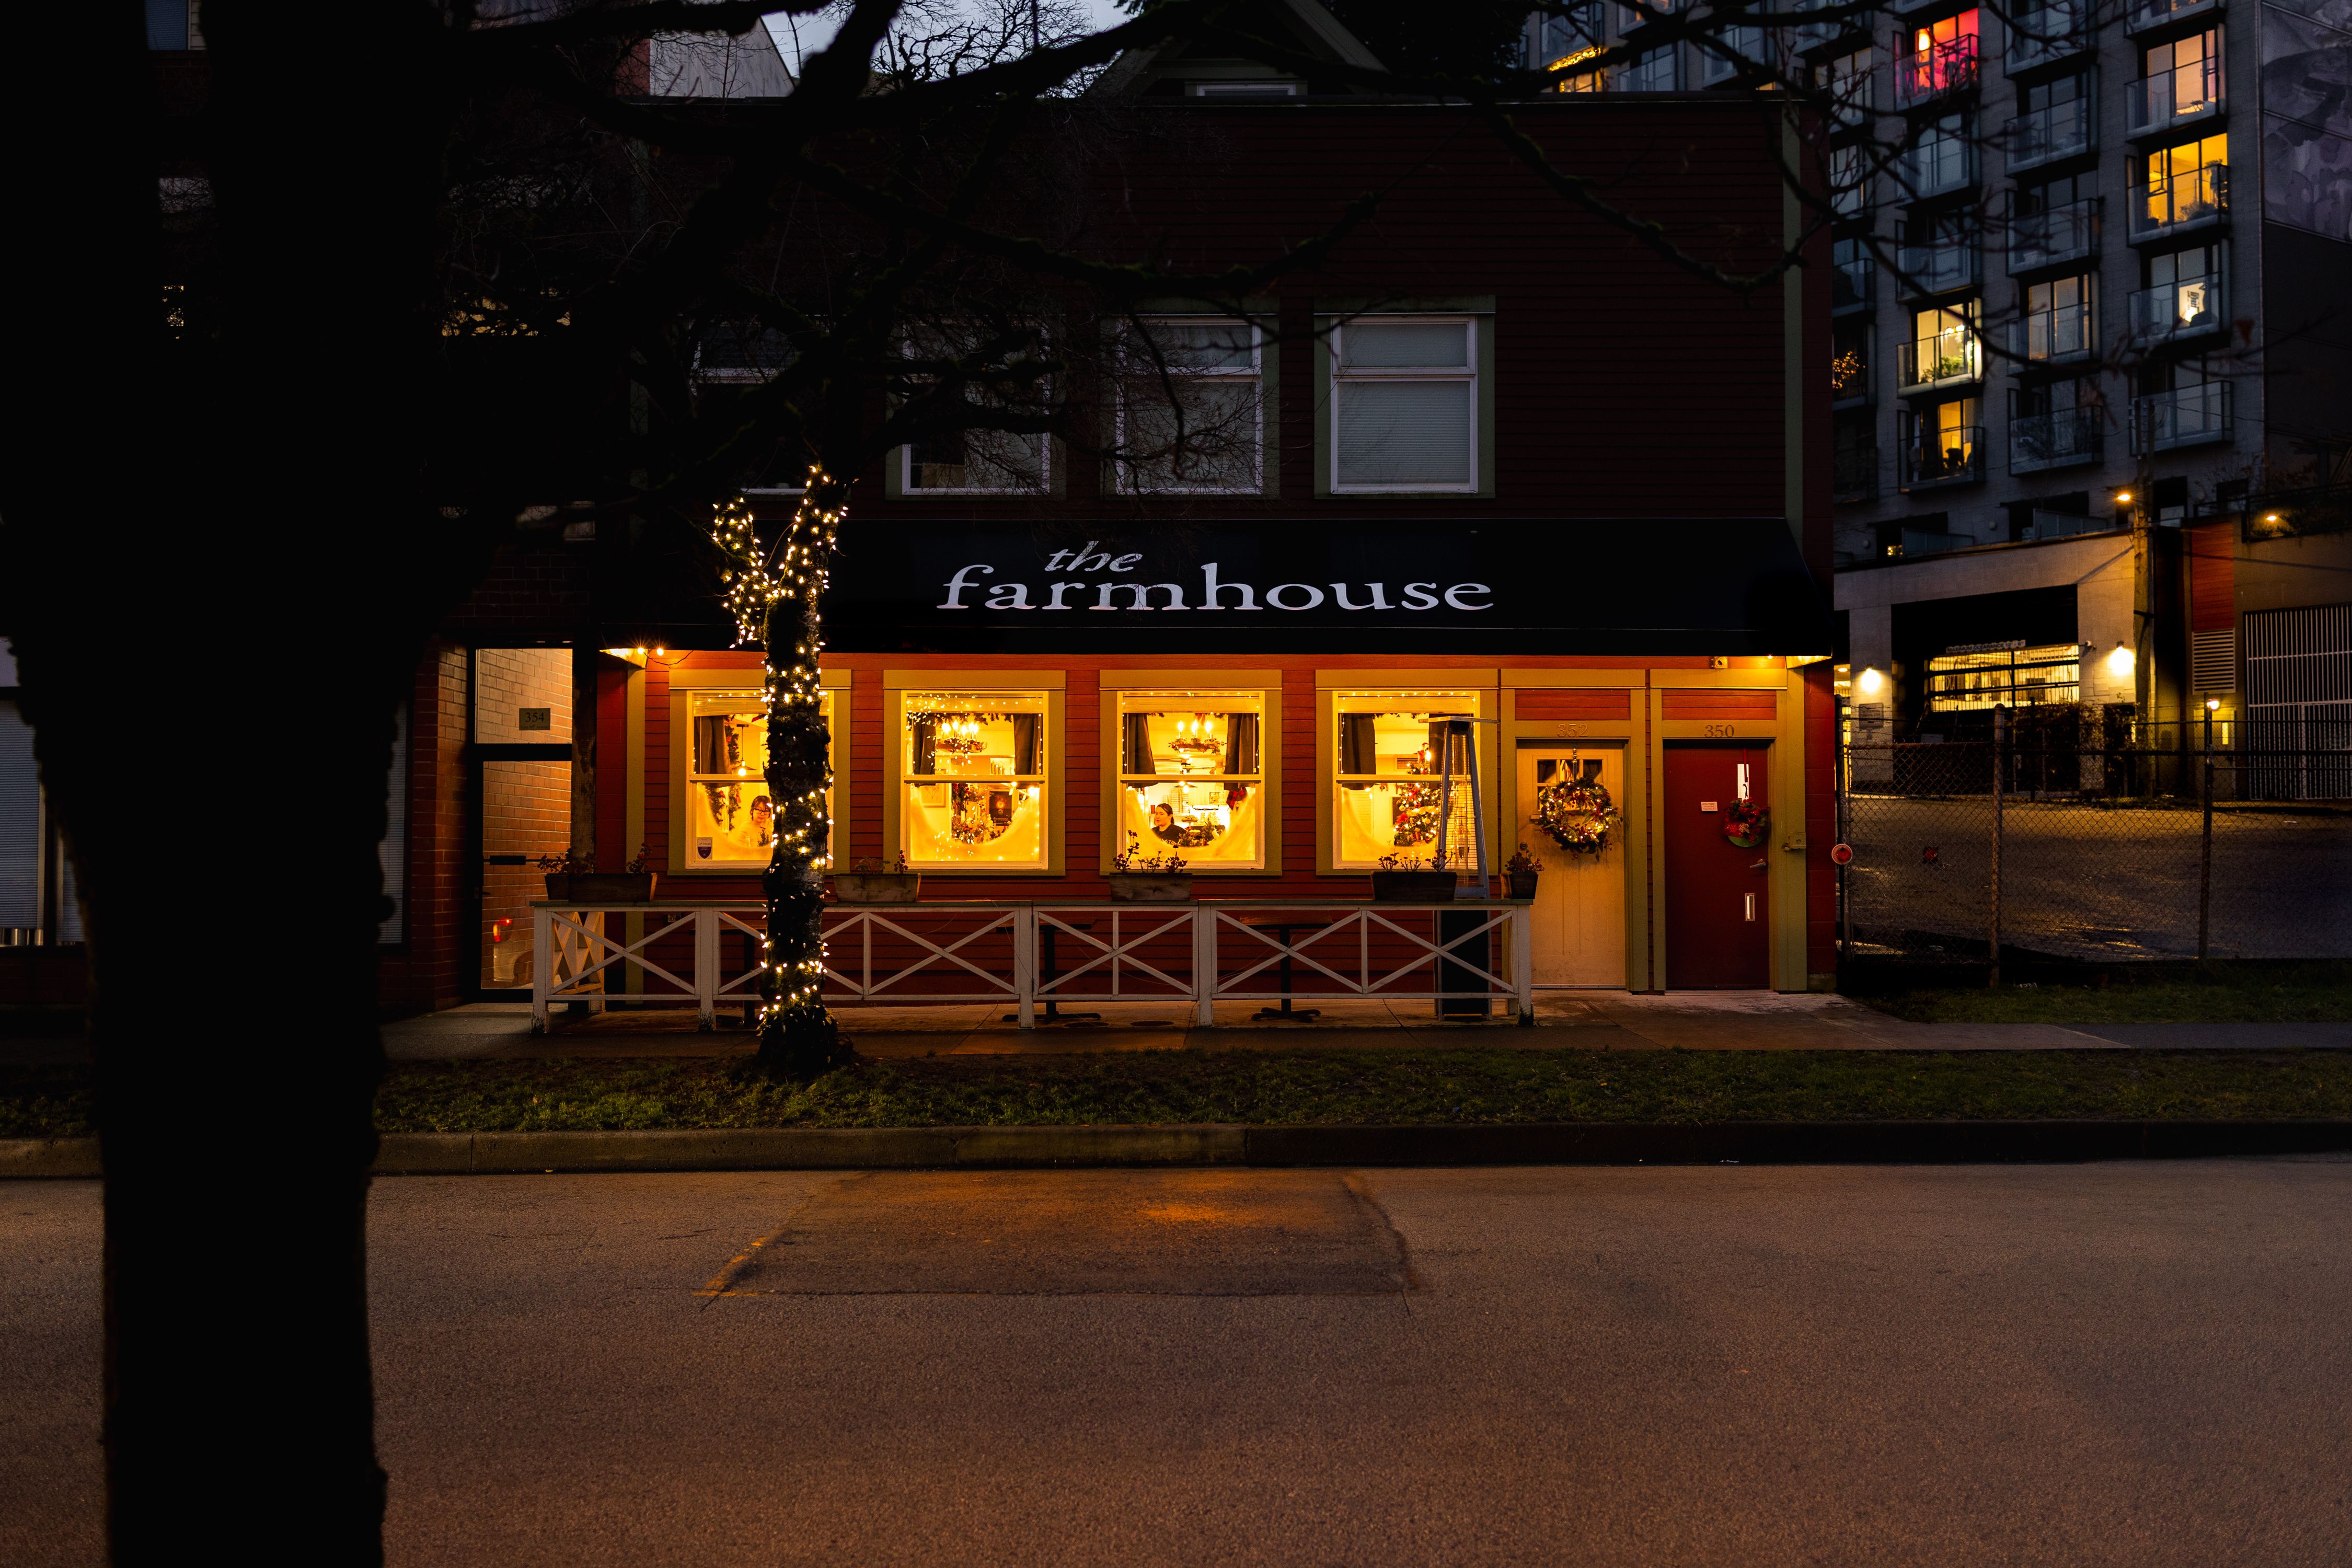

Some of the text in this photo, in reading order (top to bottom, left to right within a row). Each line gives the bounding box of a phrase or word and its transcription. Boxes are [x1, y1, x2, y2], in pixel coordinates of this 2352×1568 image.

[1045, 541, 1143, 571] the
[937, 562, 1493, 610] farmhouse
[525, 712, 545, 722] 354
[1557, 723, 1588, 737] 352
[1704, 724, 1735, 738] 350
